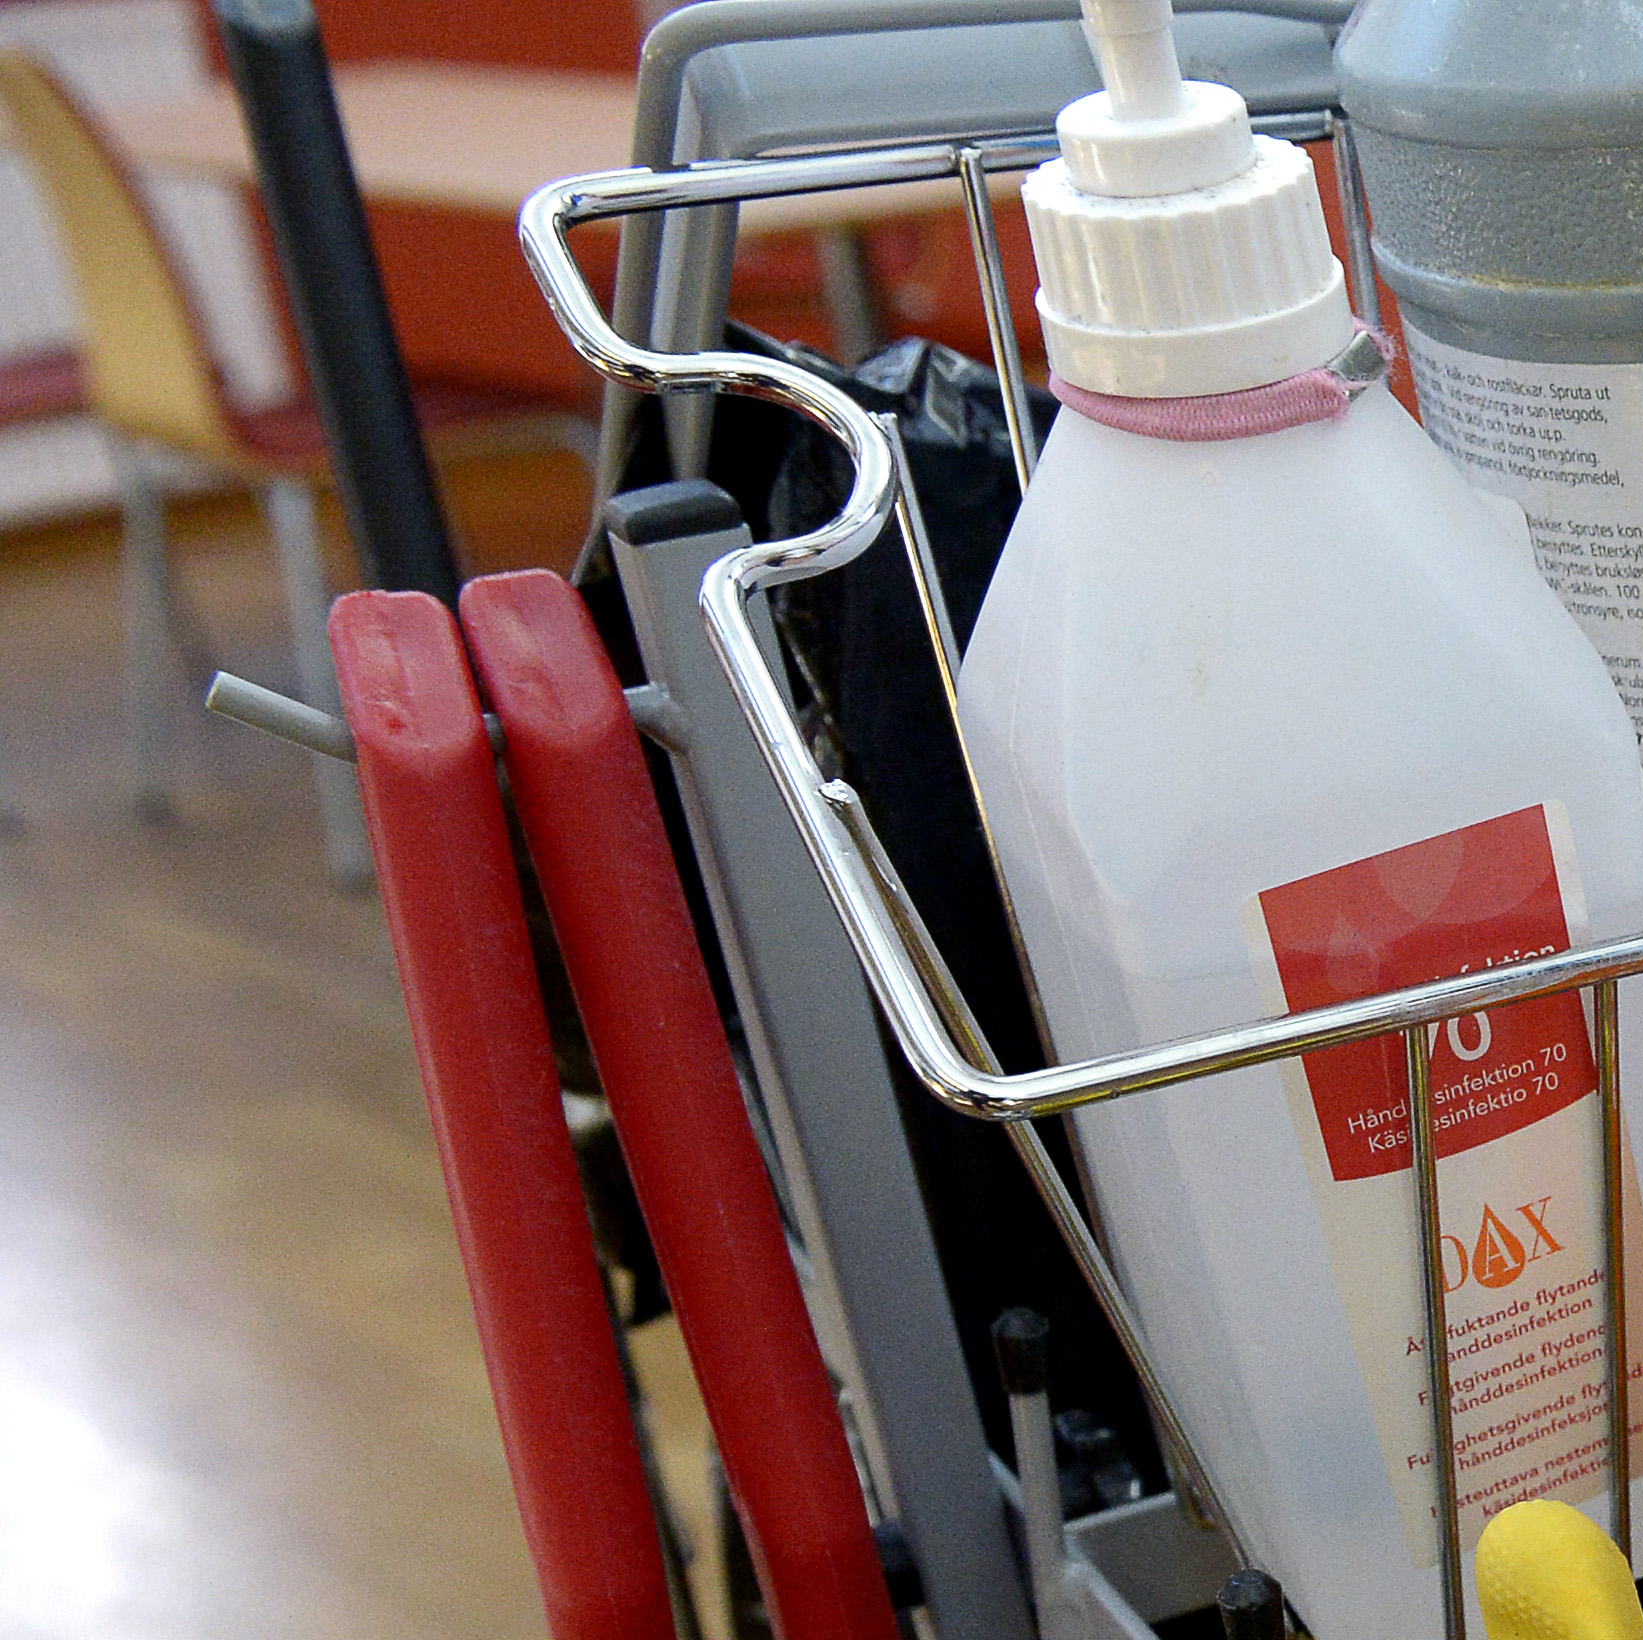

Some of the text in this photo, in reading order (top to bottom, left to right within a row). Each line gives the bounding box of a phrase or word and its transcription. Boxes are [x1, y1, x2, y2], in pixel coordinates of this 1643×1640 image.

[1549, 383, 1592, 402] Spruta
[1595, 386, 1611, 400] ut
[1506, 422, 1536, 438] torka
[1617, 584, 1640, 600] 100
[1347, 1042, 1567, 1135] Håndsinfektion 70
[1367, 1071, 1559, 1154] Käsiesinfektio 70
[1440, 1195, 1566, 1294] DAX
[1446, 1296, 1593, 1363] anddesinfektion
